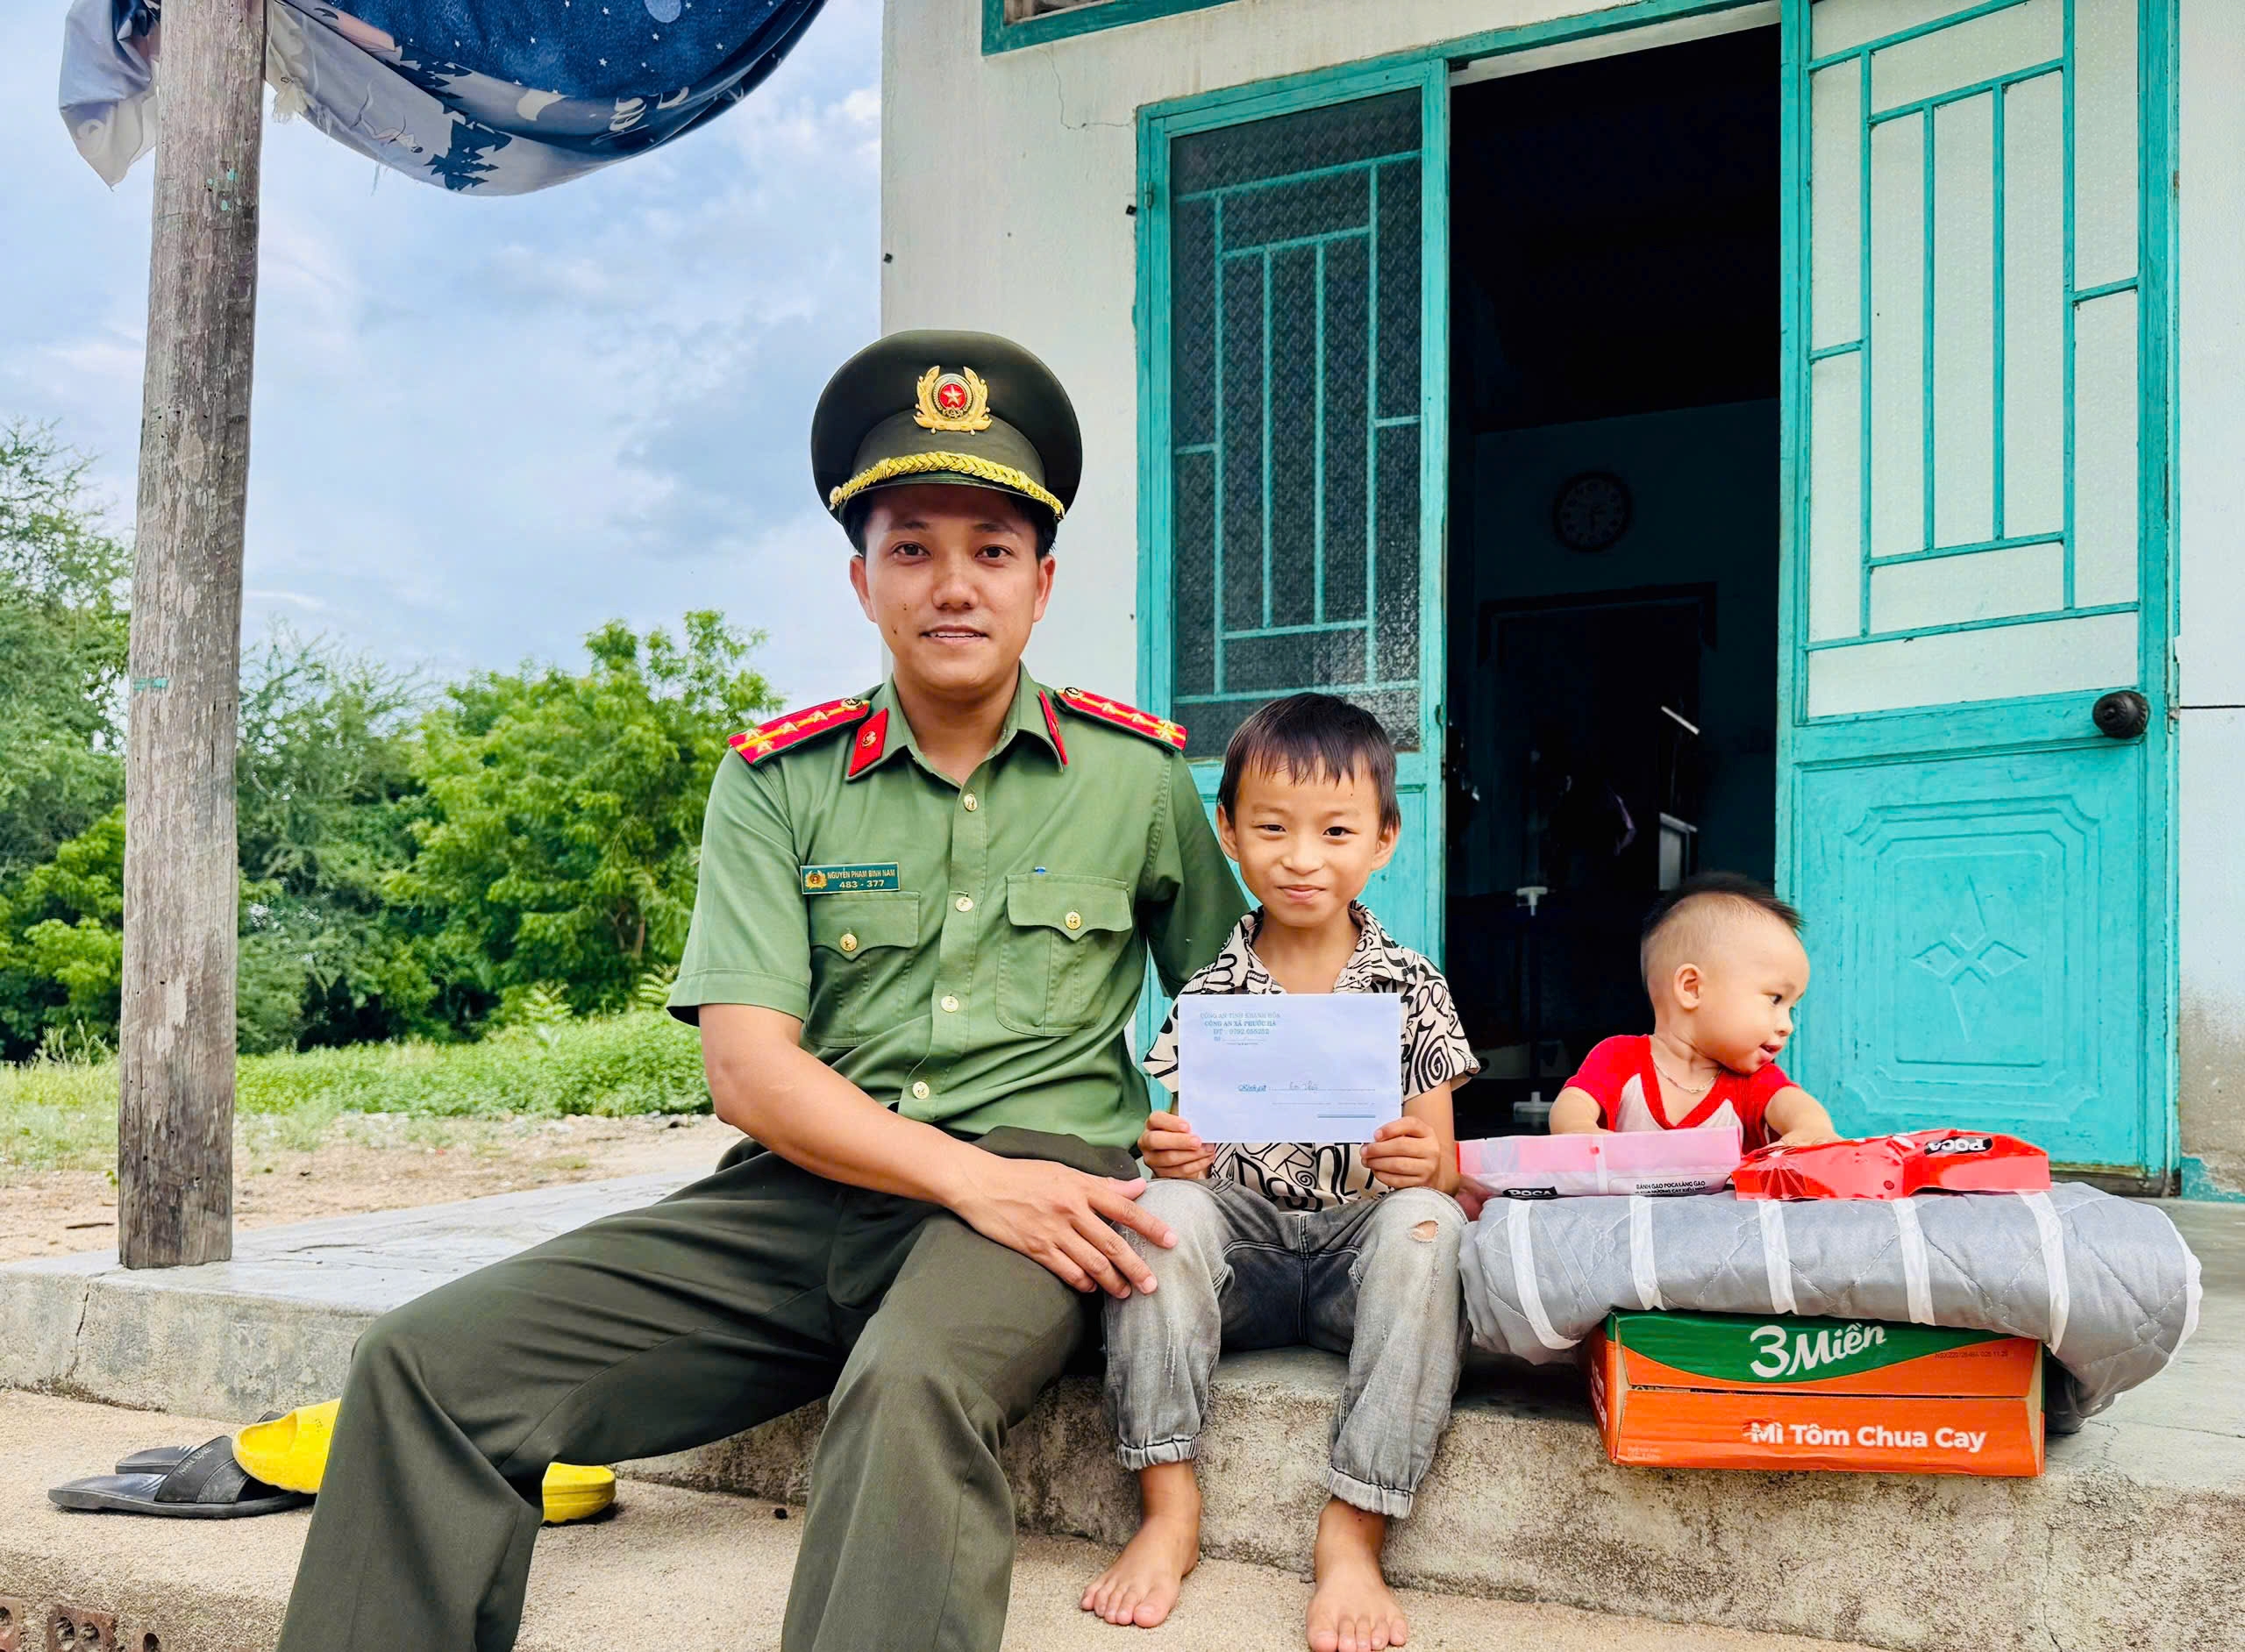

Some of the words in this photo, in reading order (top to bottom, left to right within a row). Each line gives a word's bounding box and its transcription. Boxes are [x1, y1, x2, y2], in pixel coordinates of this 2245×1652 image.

[1928, 1138, 1987, 1152] POCA
[1750, 1324, 1791, 1378] 3
[1785, 1322, 1887, 1375] Miền
[1750, 1422, 1784, 1445] Mì
[1789, 1424, 1850, 1446] Tôm
[1856, 1426, 1928, 1448] Chua
[1935, 1428, 1987, 1453] Cay
